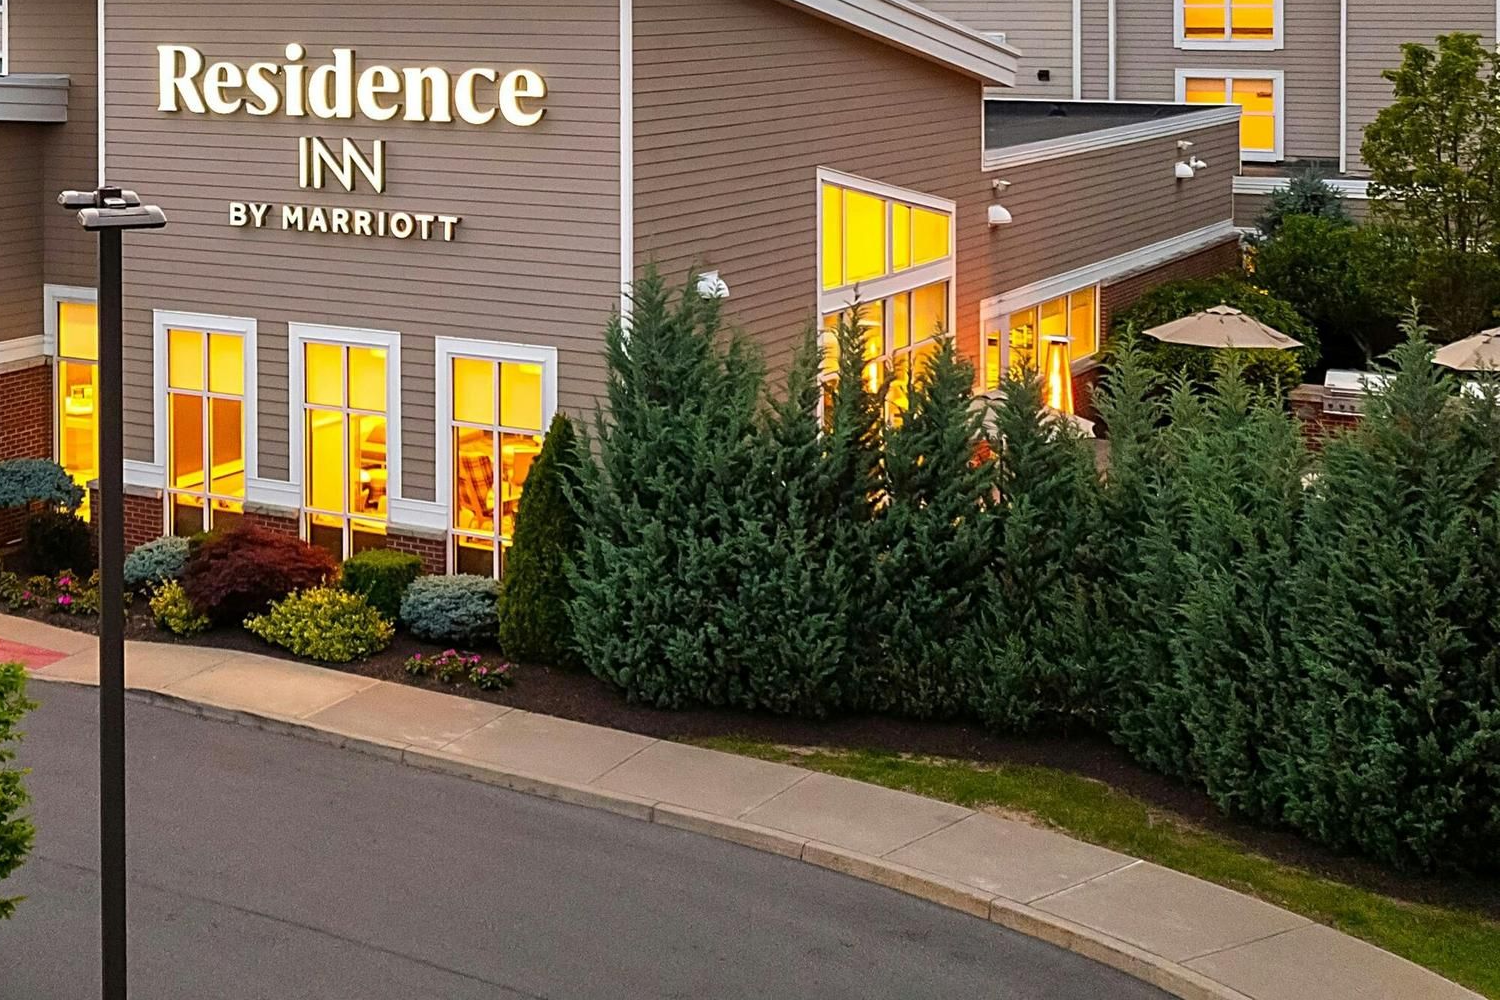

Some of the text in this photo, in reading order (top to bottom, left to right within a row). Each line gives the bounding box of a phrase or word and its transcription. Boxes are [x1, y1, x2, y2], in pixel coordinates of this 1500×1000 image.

[156, 43, 546, 126] Residence
[299, 137, 385, 193] INN
[229, 202, 459, 241] BY MARRIOTT
